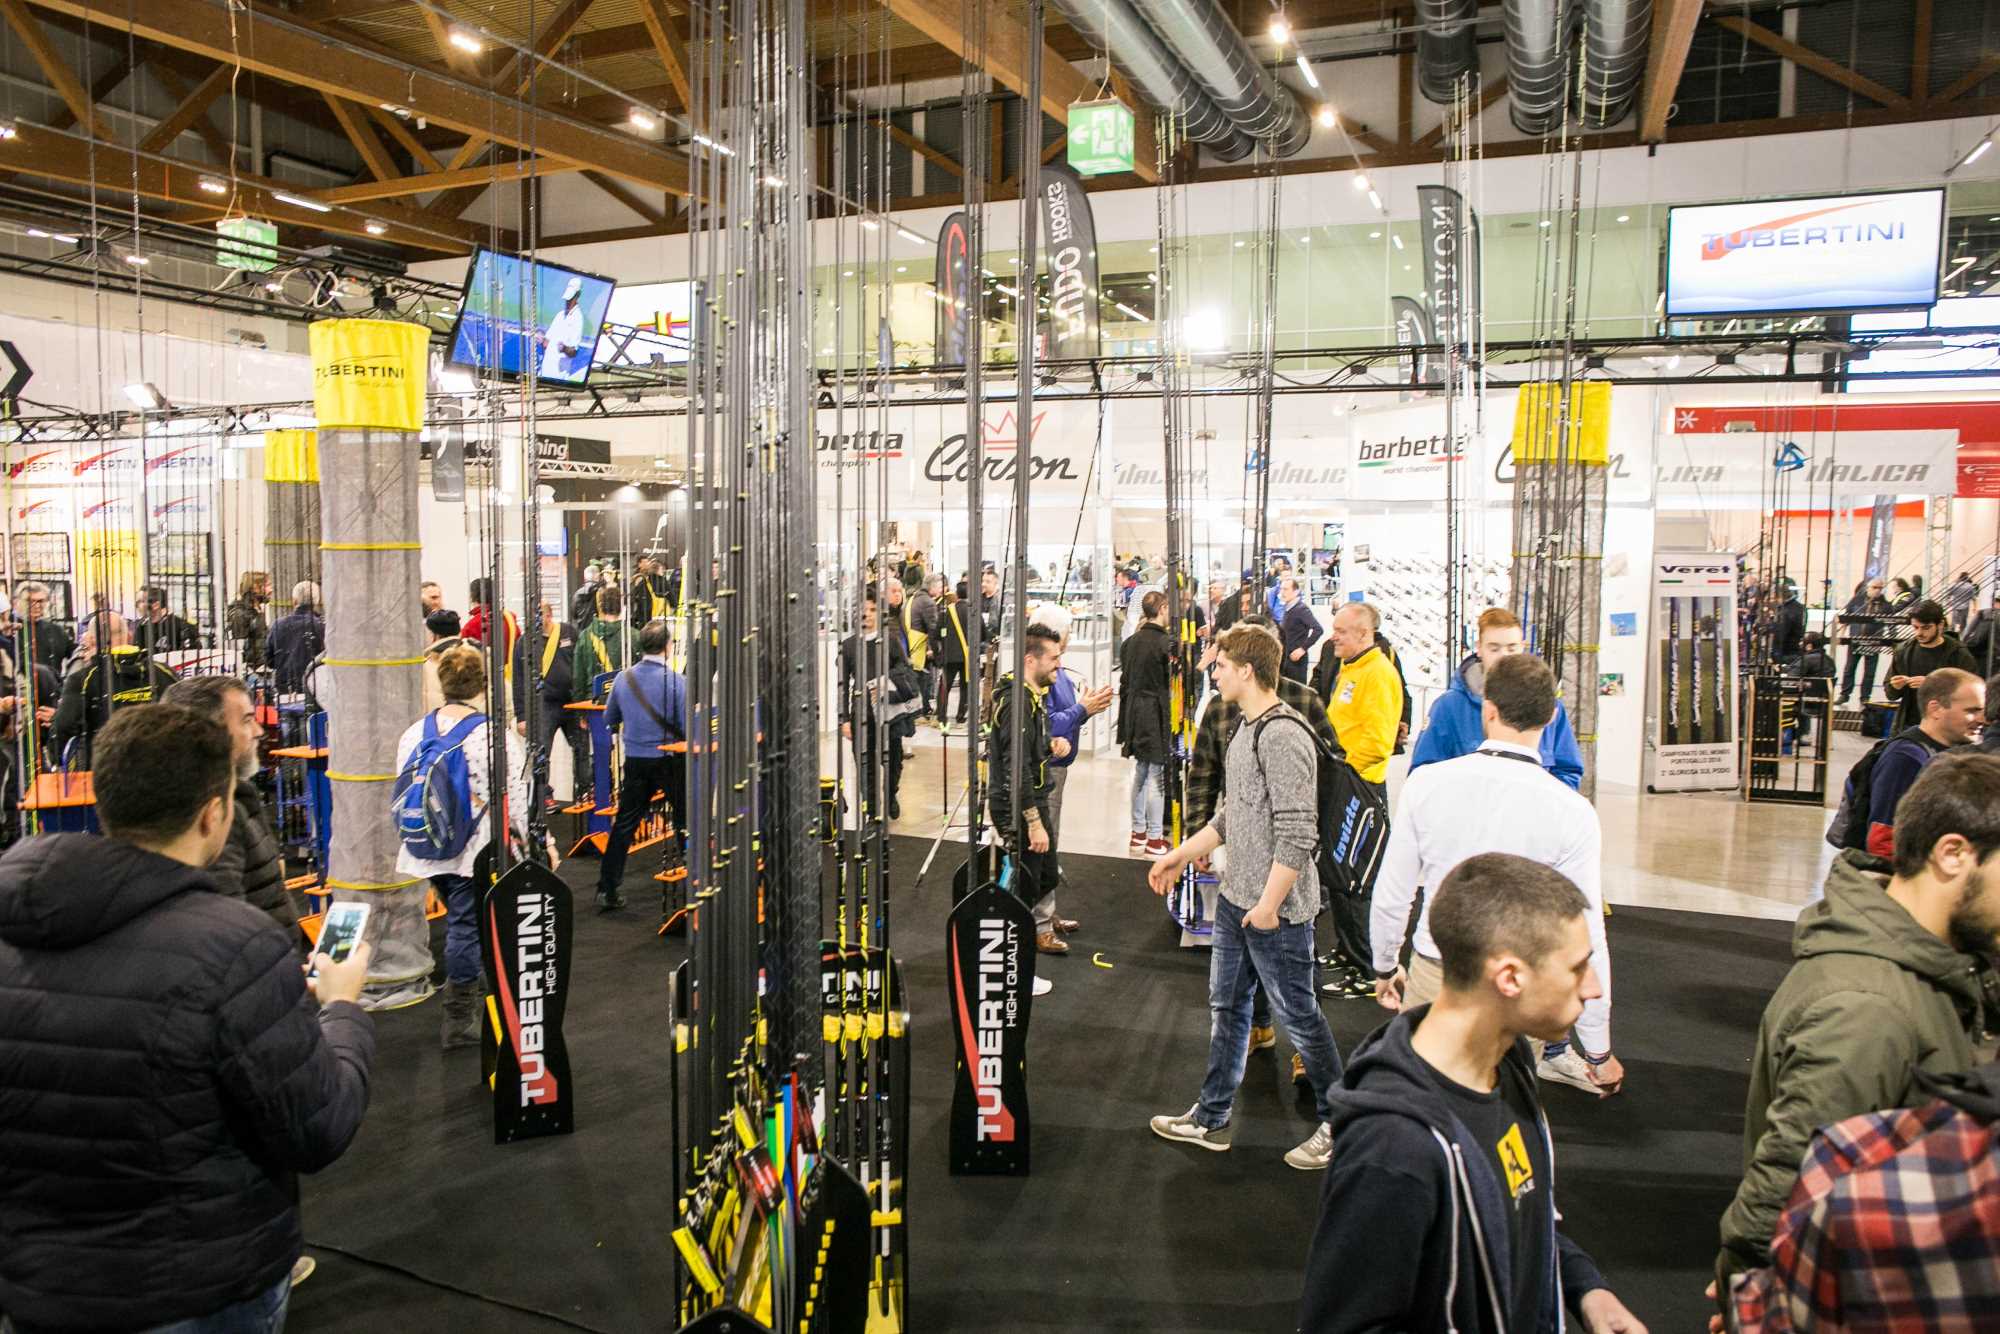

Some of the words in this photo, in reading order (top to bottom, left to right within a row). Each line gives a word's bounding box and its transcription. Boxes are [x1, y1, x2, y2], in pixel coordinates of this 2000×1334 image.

[1702, 222, 1904, 251] TUBERTINI
[816, 430, 904, 450] betta
[544, 893, 557, 956] QUALITY
[545, 959, 557, 995] HIGH
[1006, 920, 1019, 985] QUALITY
[517, 893, 545, 1107] TUBERTINI
[1006, 991, 1018, 1028] HIGH
[977, 919, 1004, 1142] TUBERTINI
